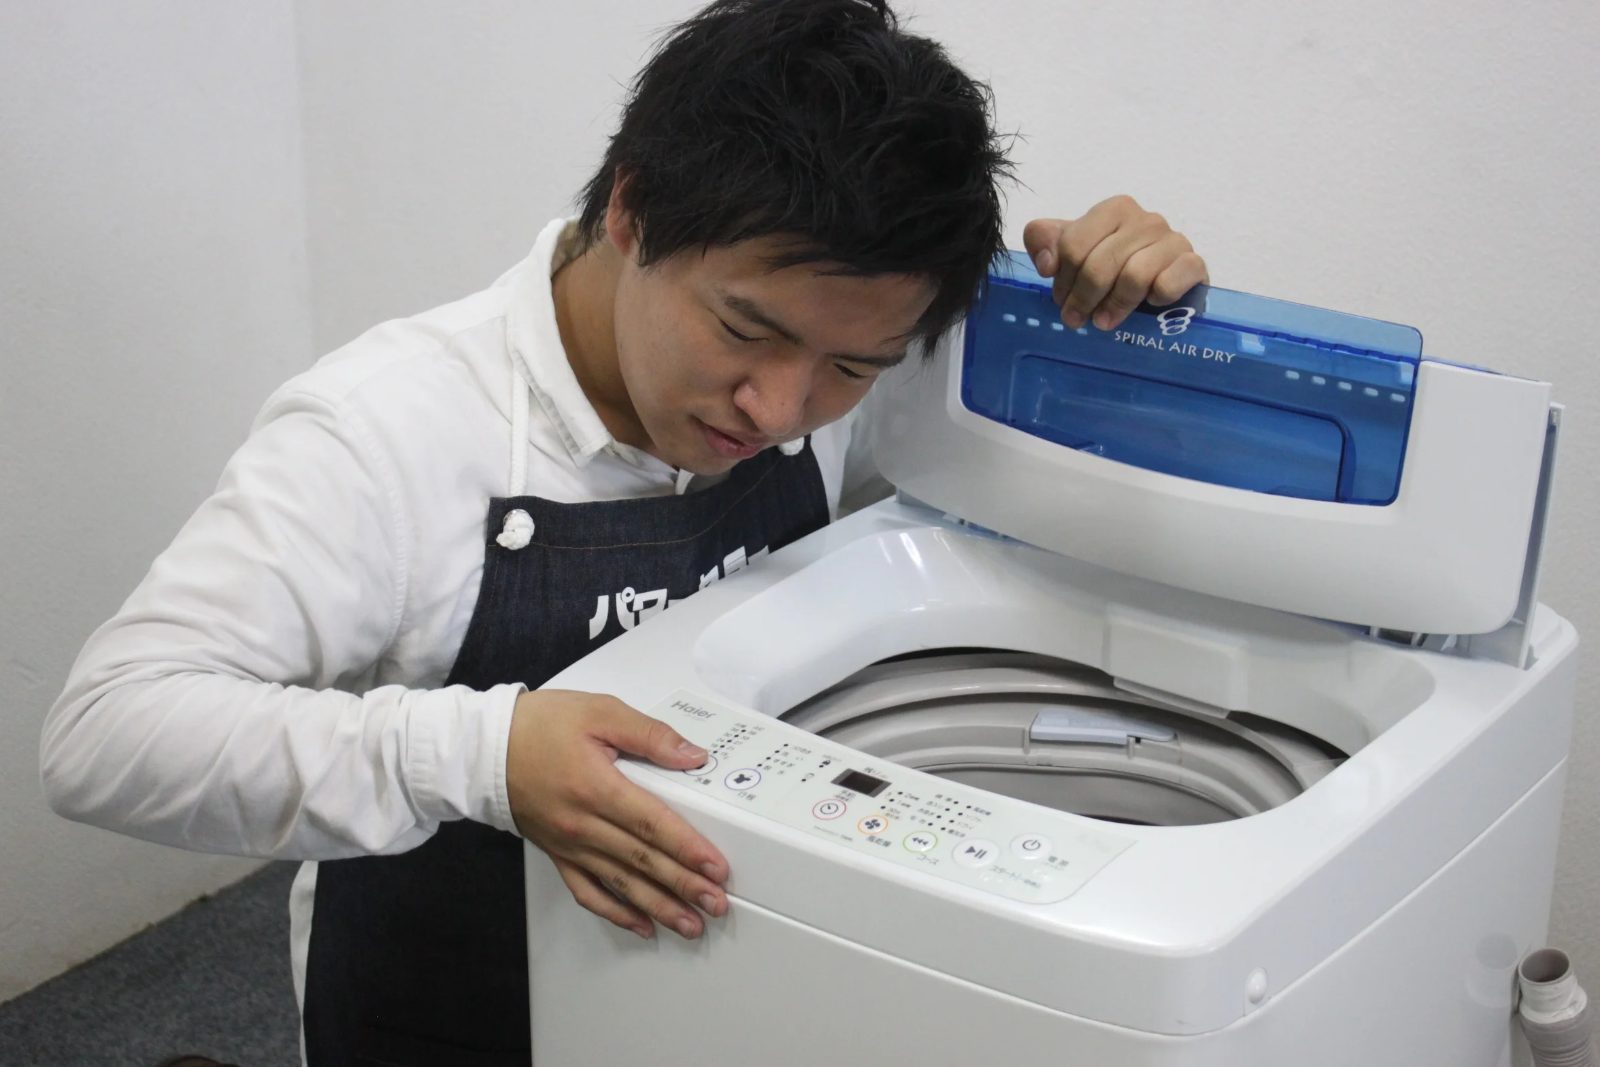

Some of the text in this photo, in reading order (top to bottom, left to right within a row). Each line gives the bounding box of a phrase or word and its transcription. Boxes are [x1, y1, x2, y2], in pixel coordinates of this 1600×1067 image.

[1114, 330, 1236, 364] SPIRAL AIR DRY
[670, 700, 717, 719] Haier
